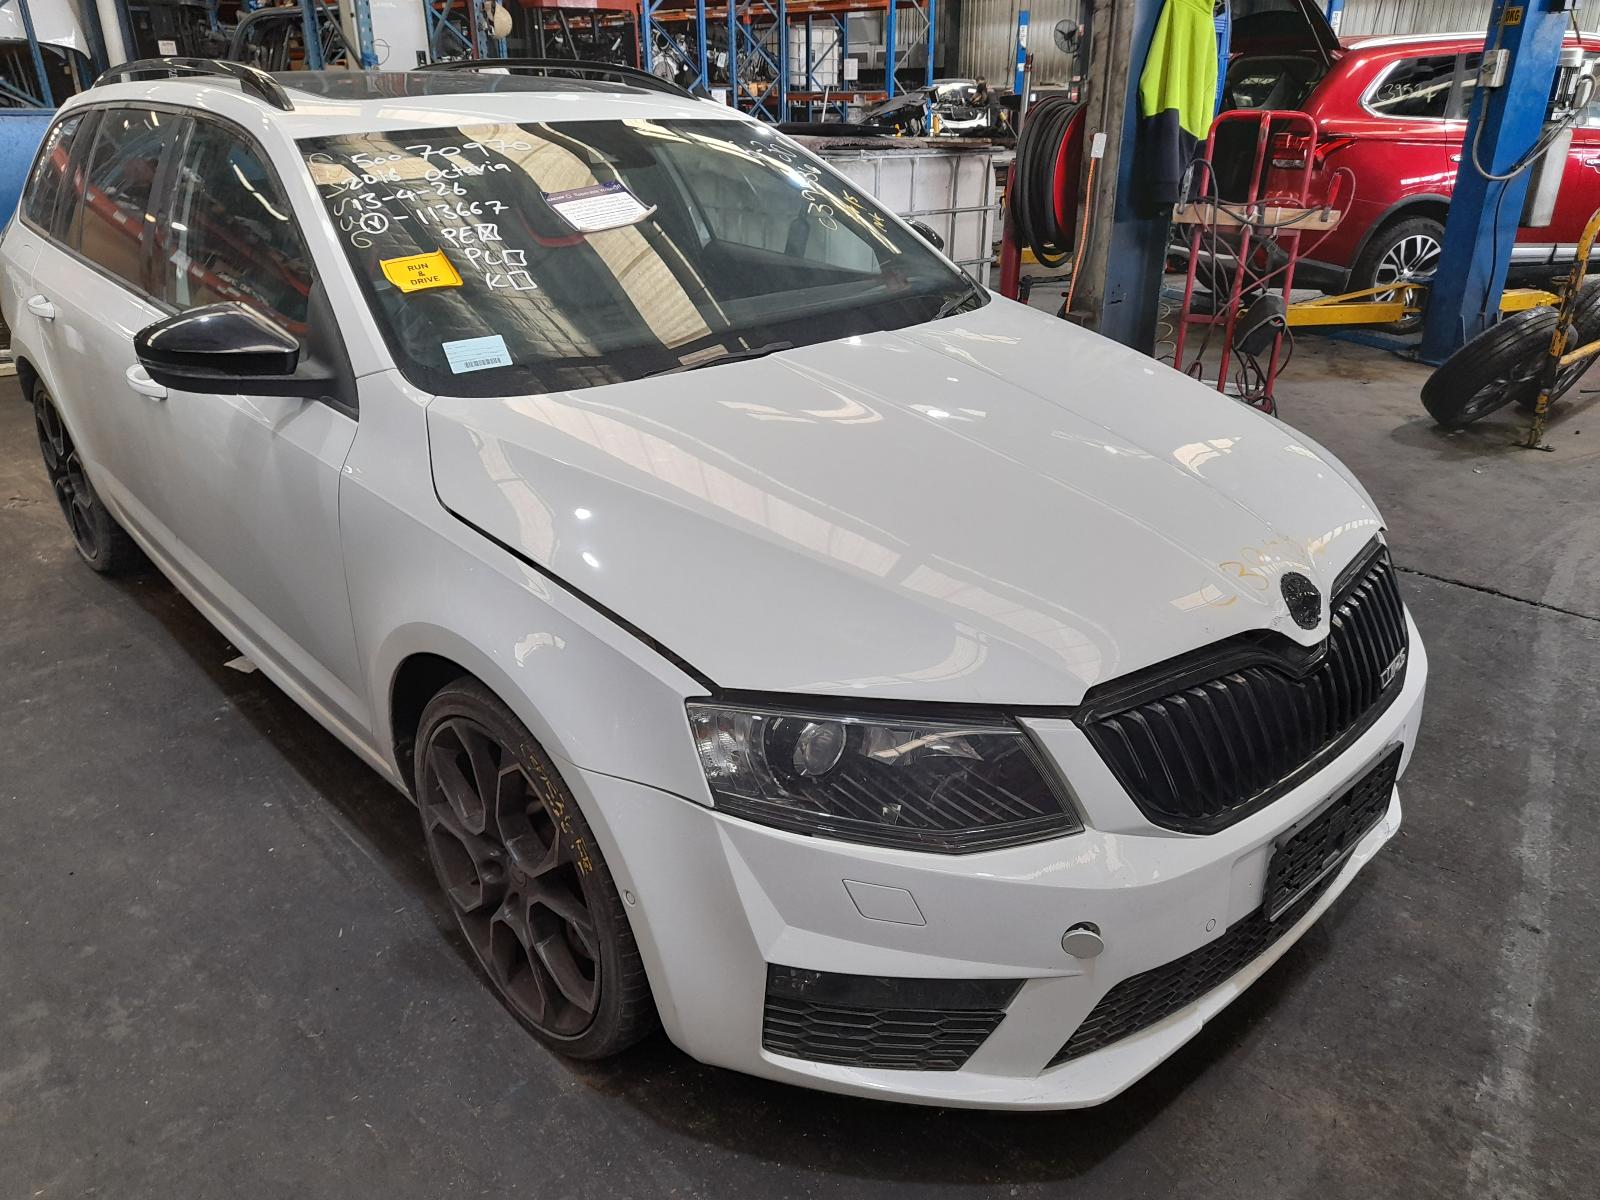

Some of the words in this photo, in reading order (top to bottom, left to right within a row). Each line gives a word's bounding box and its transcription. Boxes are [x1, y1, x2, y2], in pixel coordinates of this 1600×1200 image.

[349, 169, 401, 190] 2016
[407, 262, 429, 272] RUN
[410, 275, 441, 286] DRIVE
